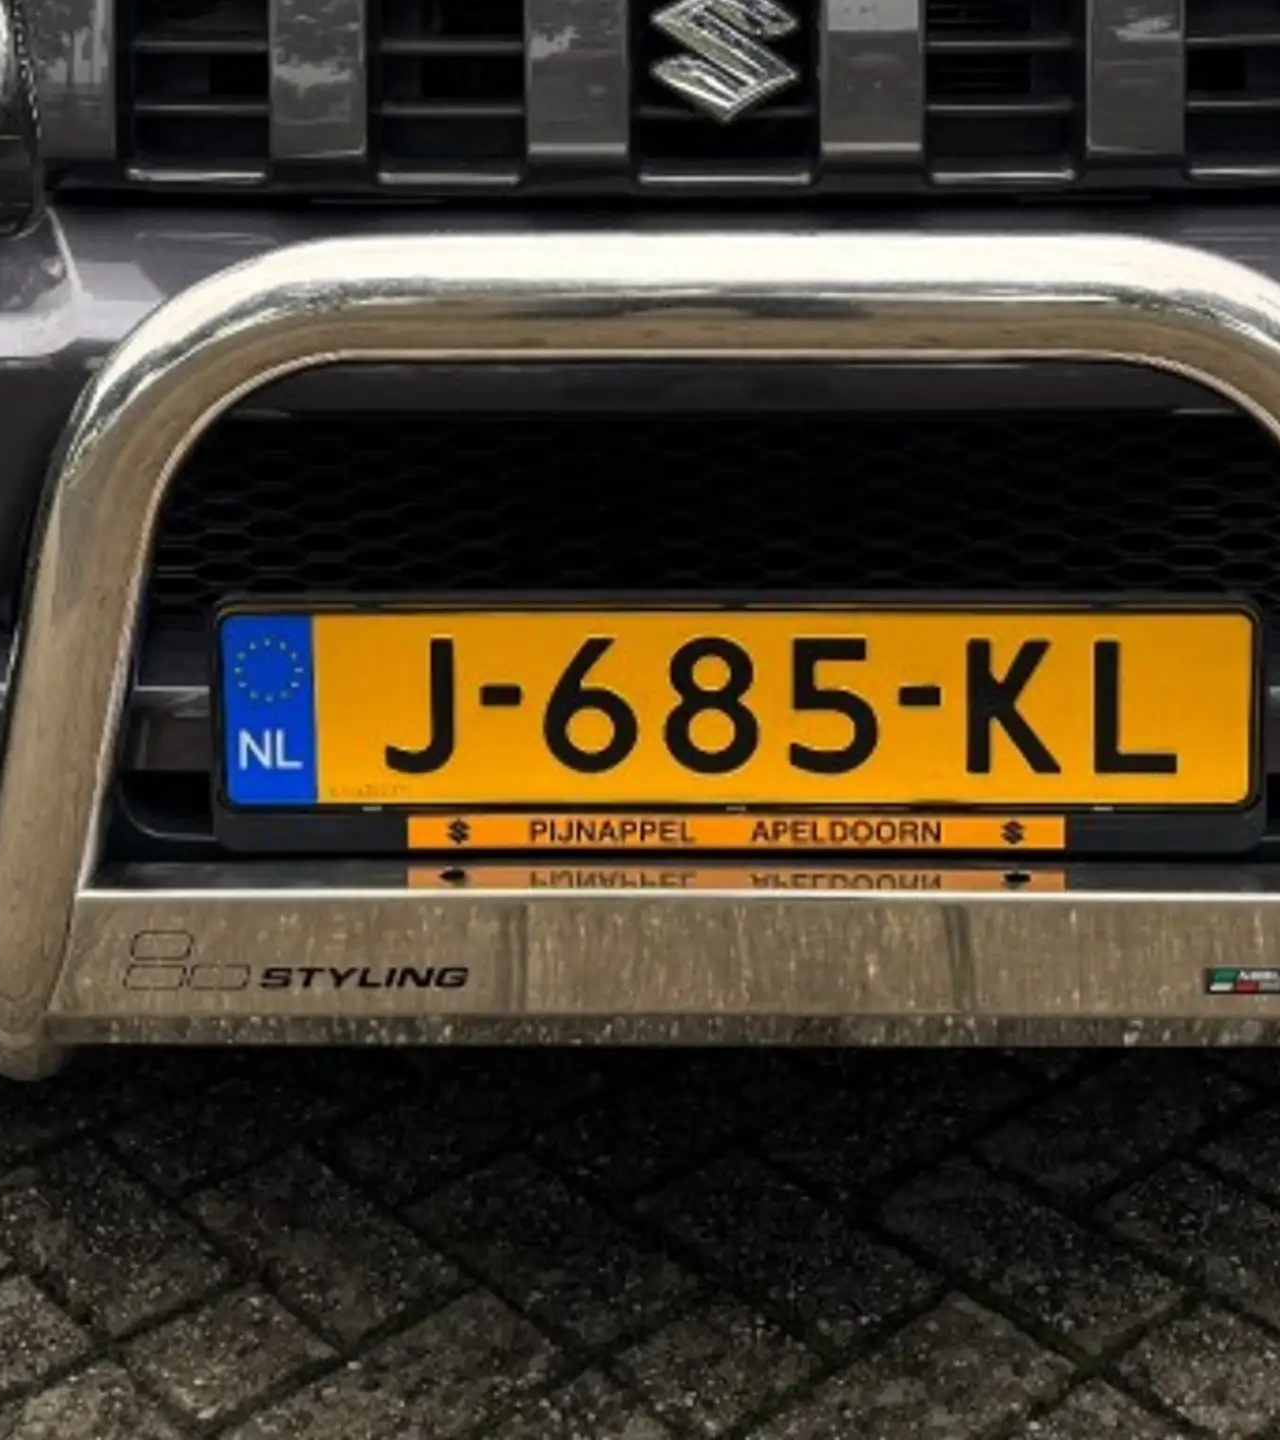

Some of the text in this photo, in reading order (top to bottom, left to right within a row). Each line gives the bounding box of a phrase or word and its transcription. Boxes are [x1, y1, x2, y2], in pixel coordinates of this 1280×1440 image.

[238, 636, 1178, 775] NL J-685-KL
[529, 820, 942, 844] PIJNAPPEL APELDOORN
[259, 966, 470, 990] STYLING
